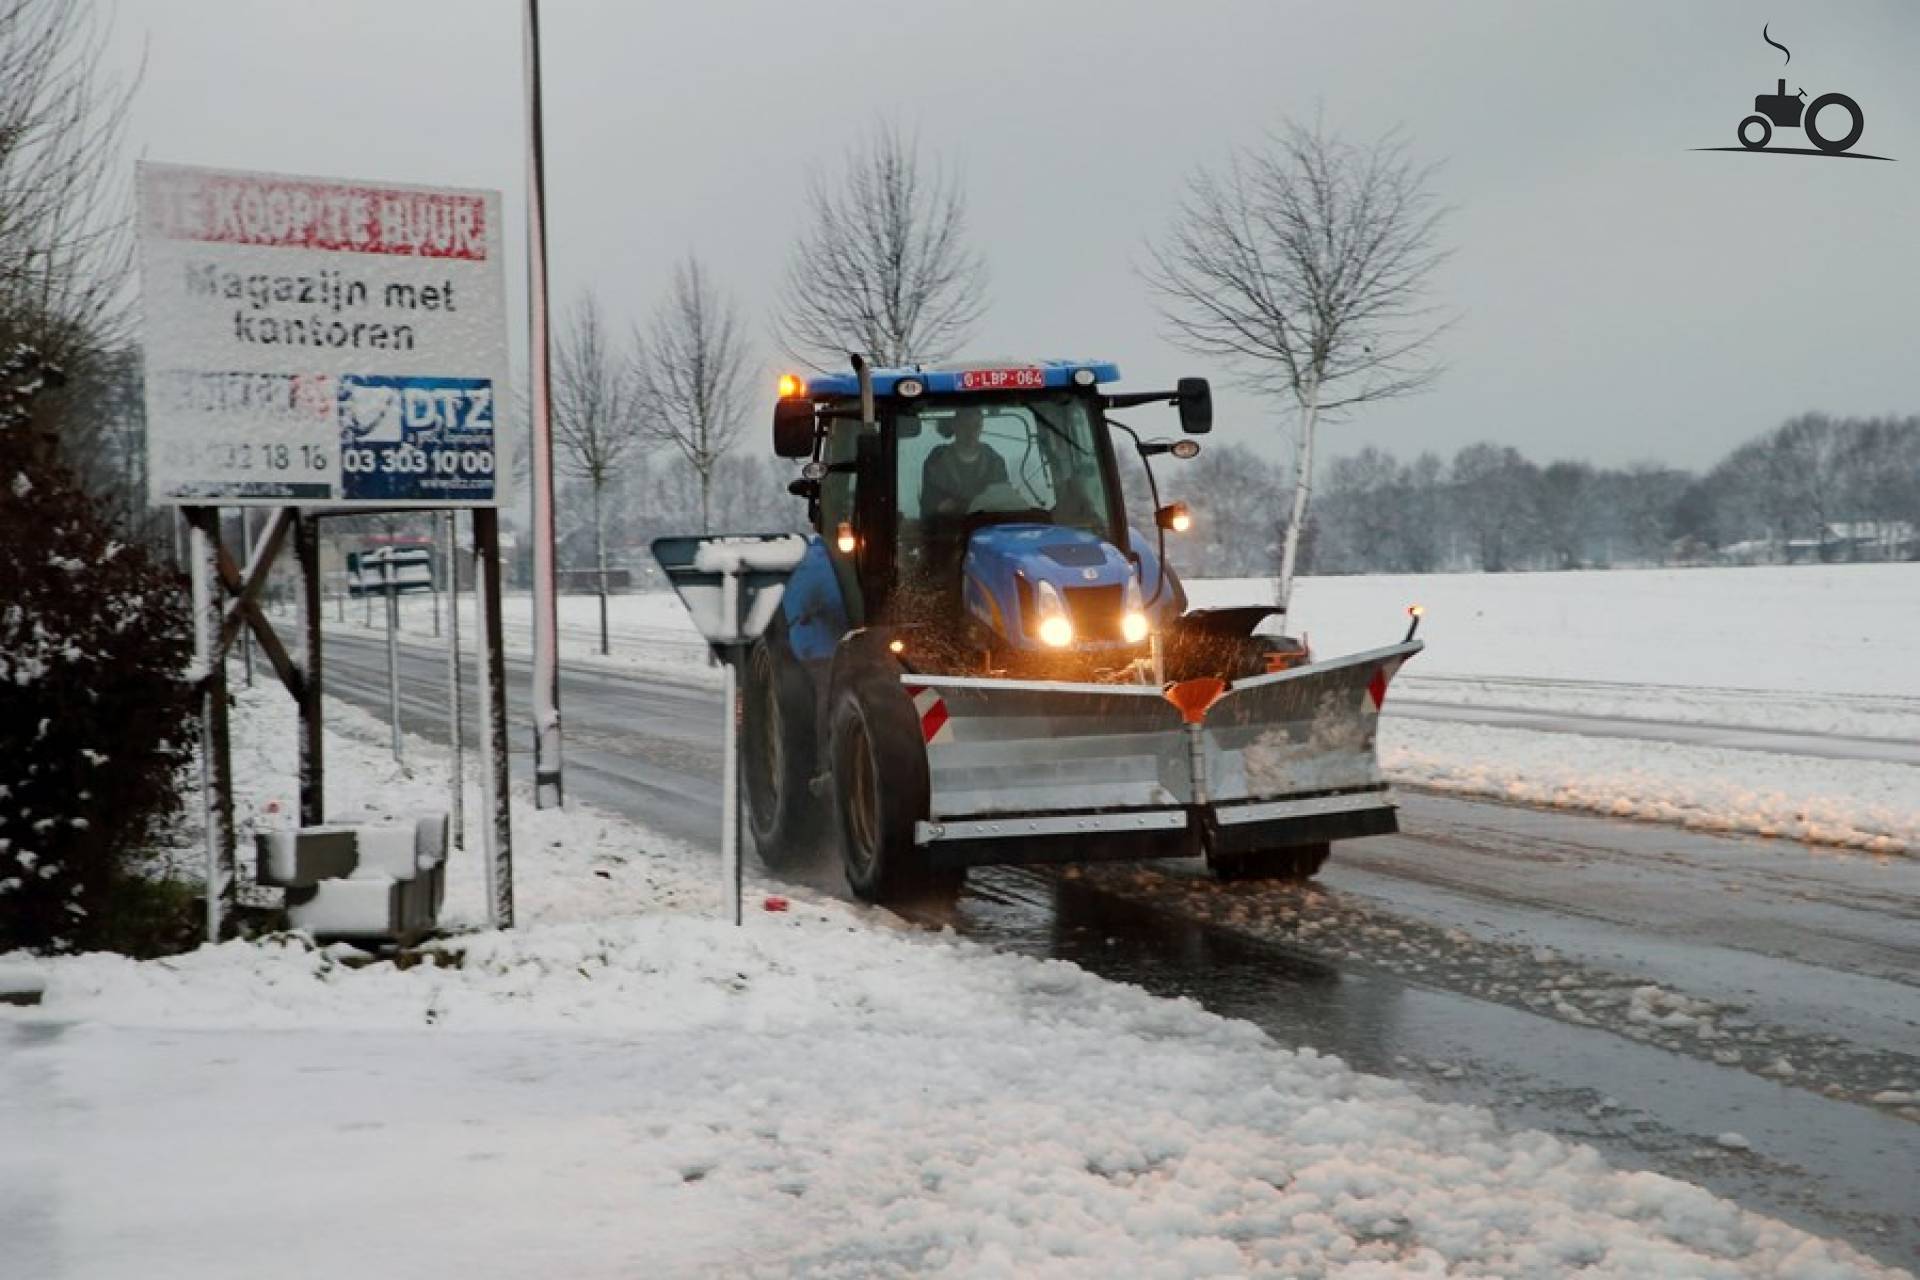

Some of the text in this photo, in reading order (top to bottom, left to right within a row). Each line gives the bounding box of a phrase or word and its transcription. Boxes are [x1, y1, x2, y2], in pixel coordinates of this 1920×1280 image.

[185, 262, 456, 312] Magazijn met
[233, 310, 414, 350] kantoren
[404, 387, 493, 429] DTZ
[261, 443, 290, 471] 18
[300, 444, 328, 471] 16
[344, 449, 494, 475] 03 303 10 00
